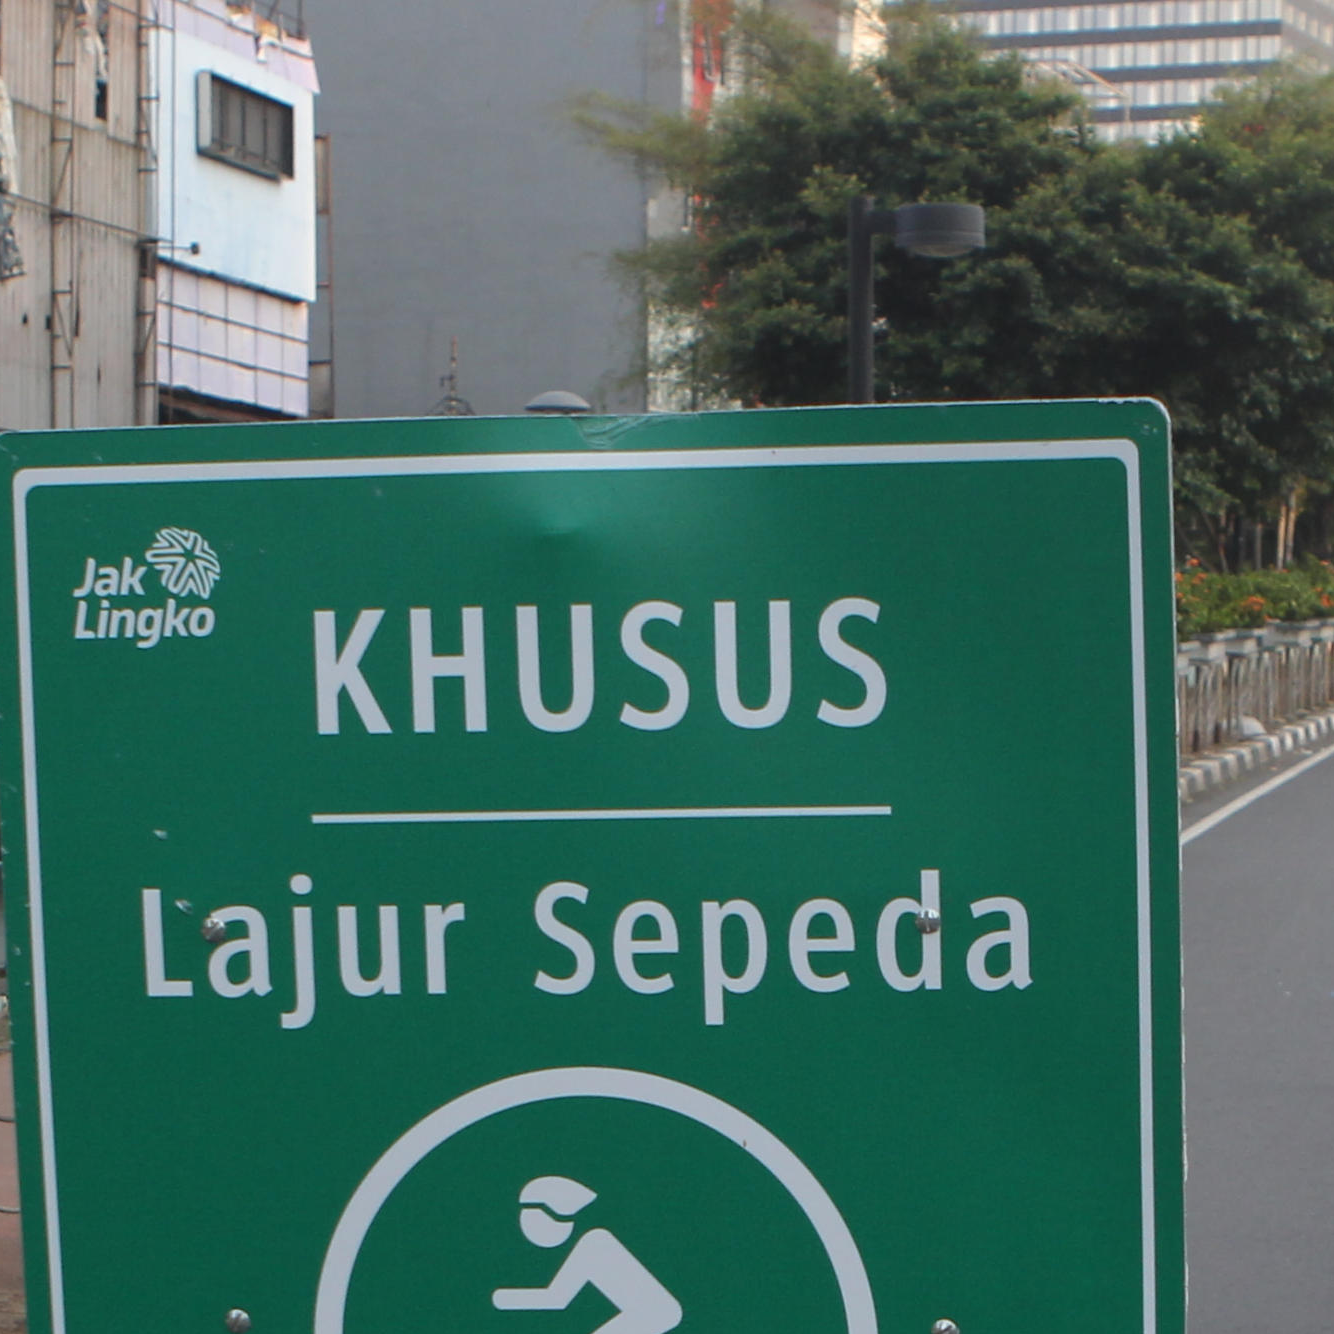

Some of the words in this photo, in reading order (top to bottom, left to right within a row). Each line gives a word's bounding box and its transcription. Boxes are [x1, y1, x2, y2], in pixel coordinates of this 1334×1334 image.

[73, 556, 147, 598] Jak
[74, 598, 216, 649] Lingko
[313, 596, 887, 735] KHUSUS
[141, 873, 465, 1029] Lajur
[534, 868, 1033, 1026] Sepeda
